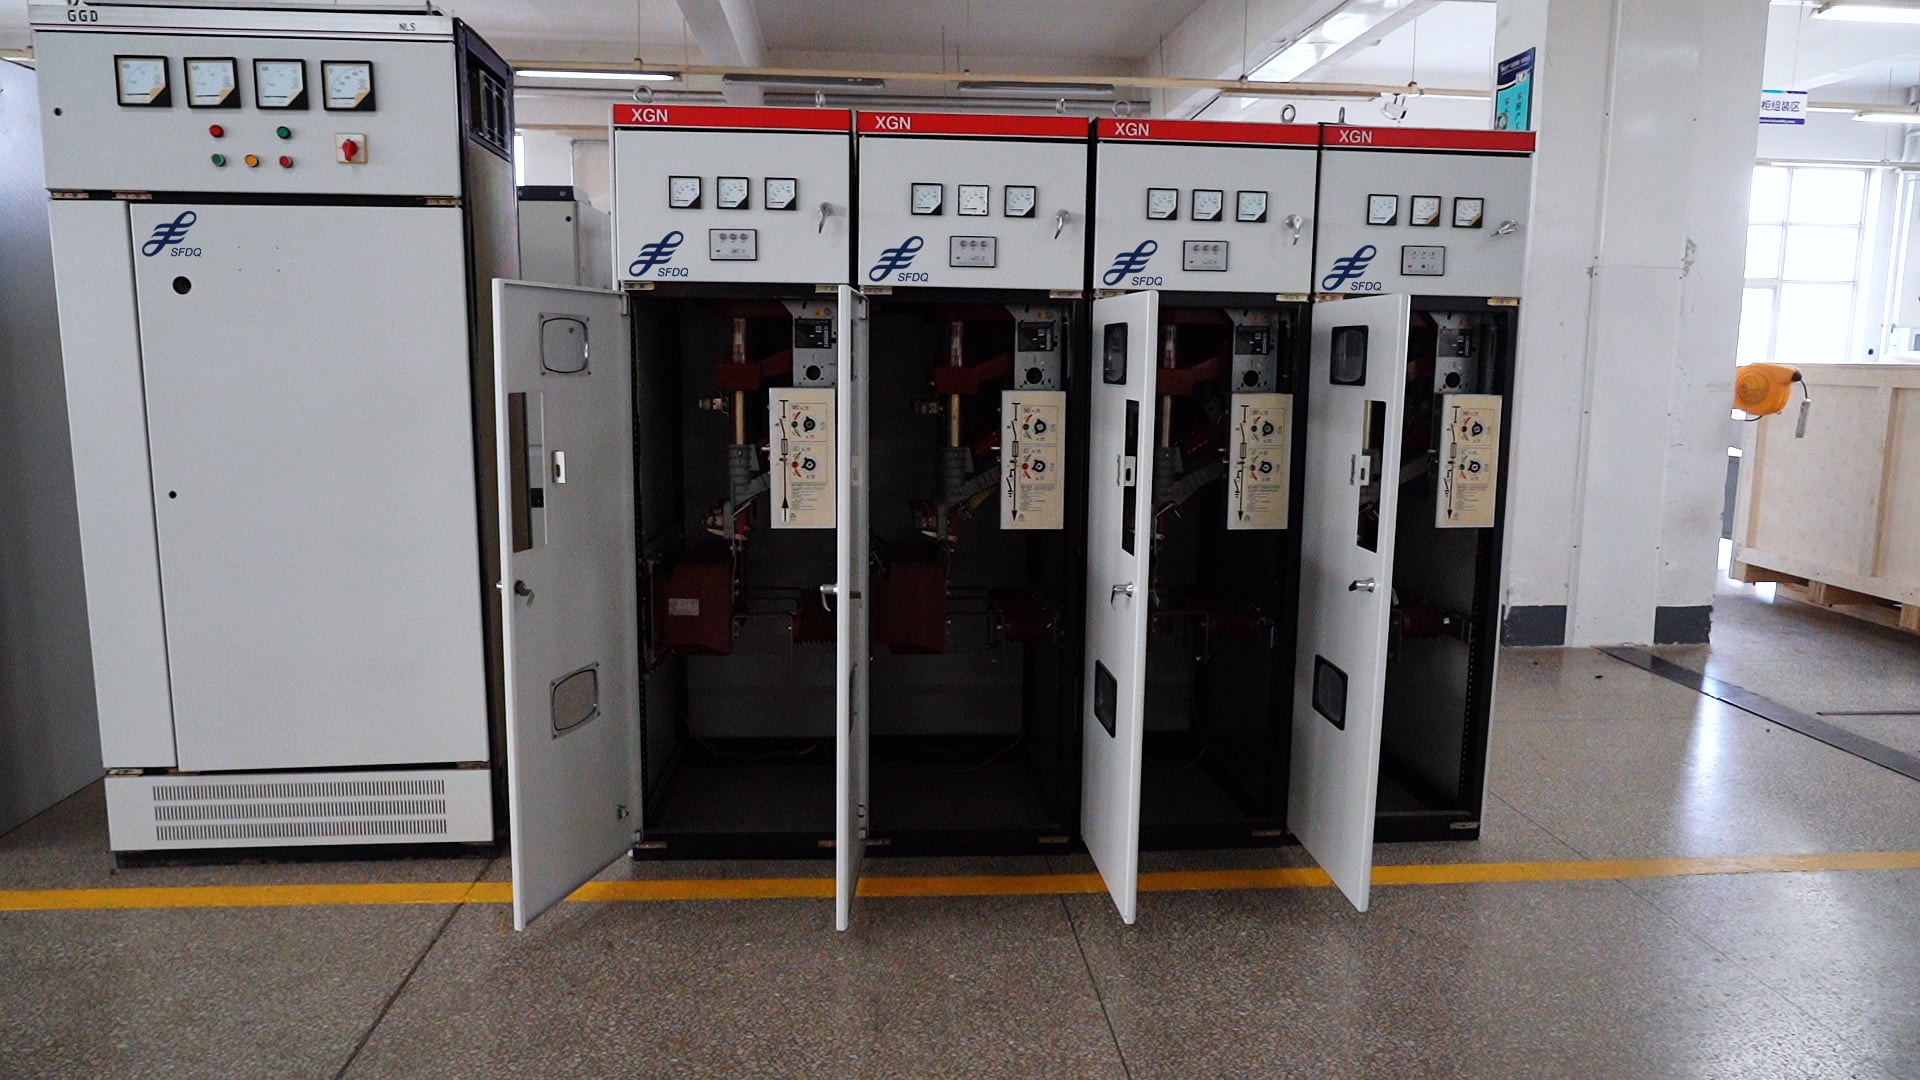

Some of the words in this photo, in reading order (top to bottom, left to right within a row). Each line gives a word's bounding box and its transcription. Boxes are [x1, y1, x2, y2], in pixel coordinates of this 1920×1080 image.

[67, 9, 98, 22] GGD
[632, 108, 668, 123] XGN
[875, 115, 911, 130] XGN
[1115, 122, 1150, 136] XGN
[1339, 129, 1373, 144] XGN
[170, 247, 202, 257] SFDQ
[657, 267, 689, 278] SFDQ
[897, 272, 929, 282] SFDQ
[1131, 276, 1163, 287] SFDQ
[1351, 281, 1382, 292] SFDQ
